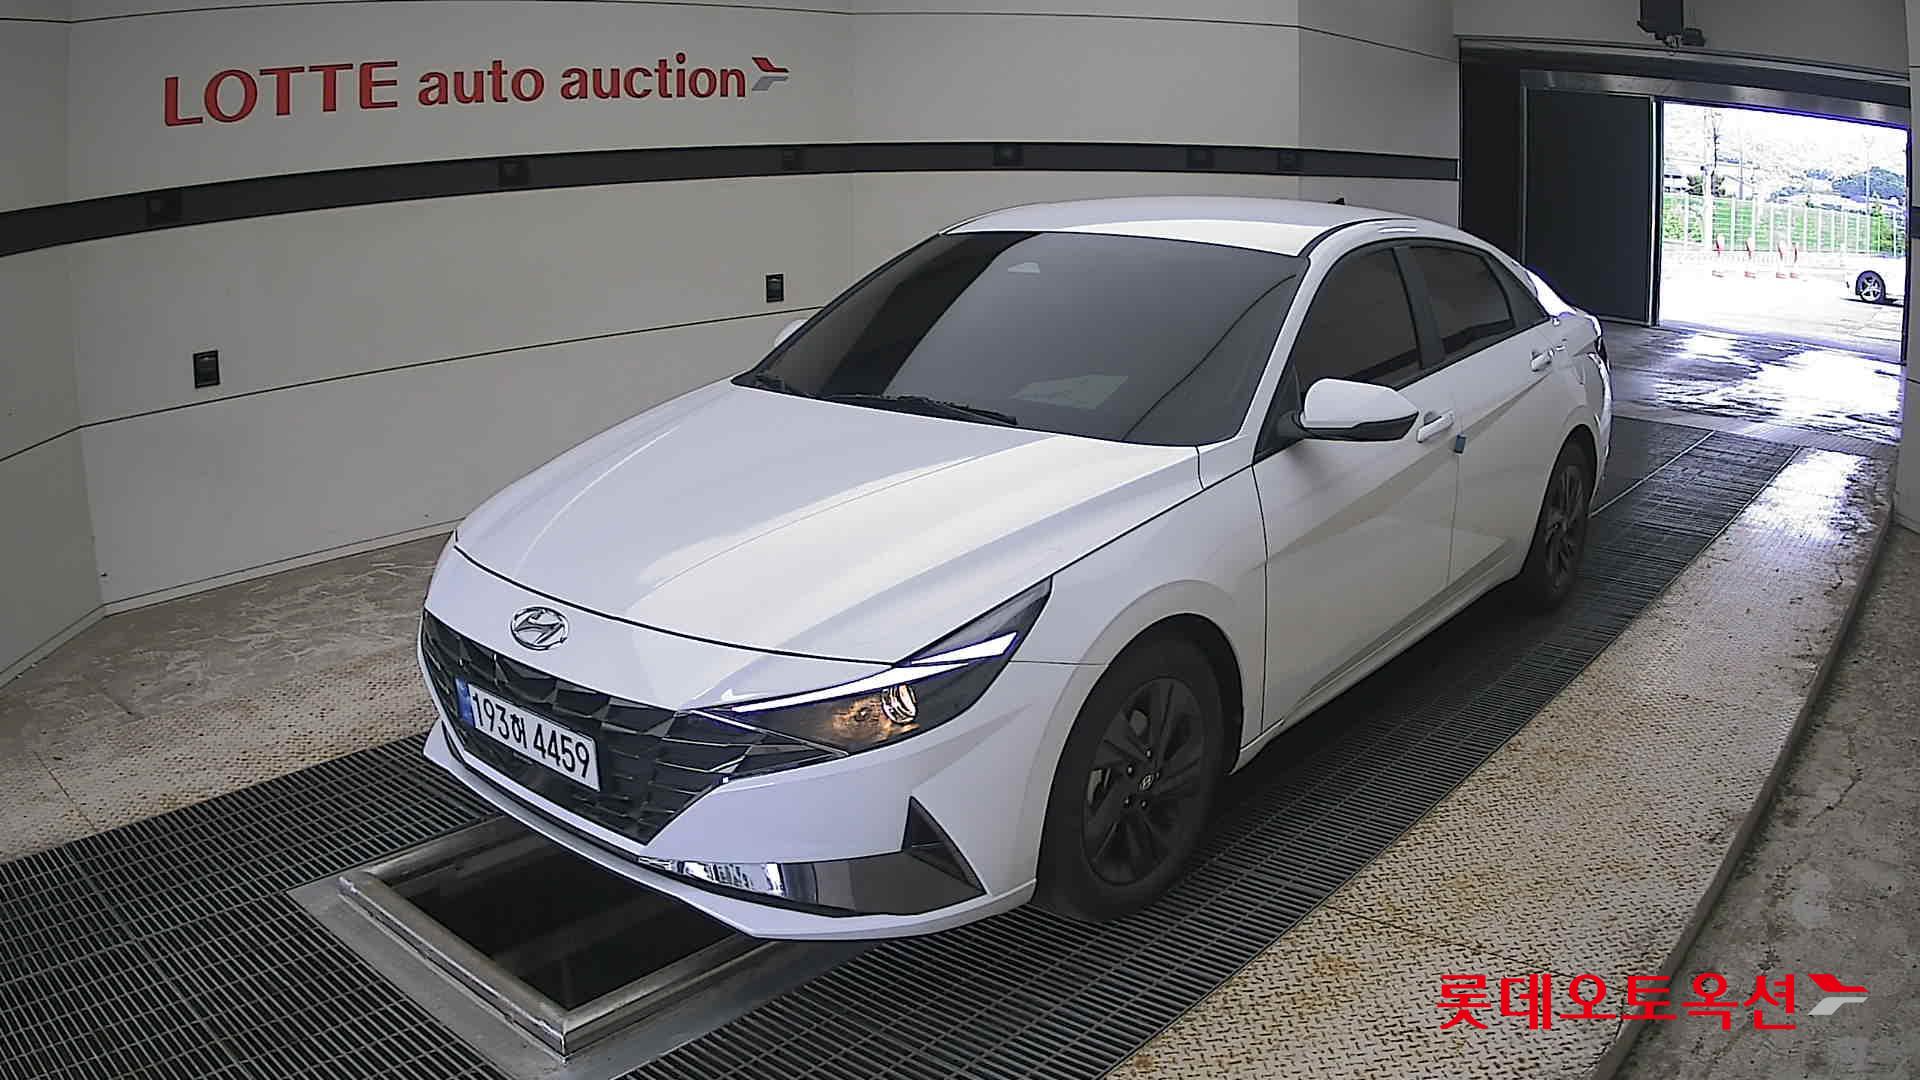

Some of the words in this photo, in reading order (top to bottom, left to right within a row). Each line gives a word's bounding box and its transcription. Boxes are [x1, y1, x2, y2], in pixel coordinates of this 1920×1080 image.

[164, 60, 398, 127] LOTTE
[418, 59, 545, 106] auto
[560, 52, 746, 99] auction
[472, 692, 528, 749] 193허
[533, 722, 590, 778] 4459
